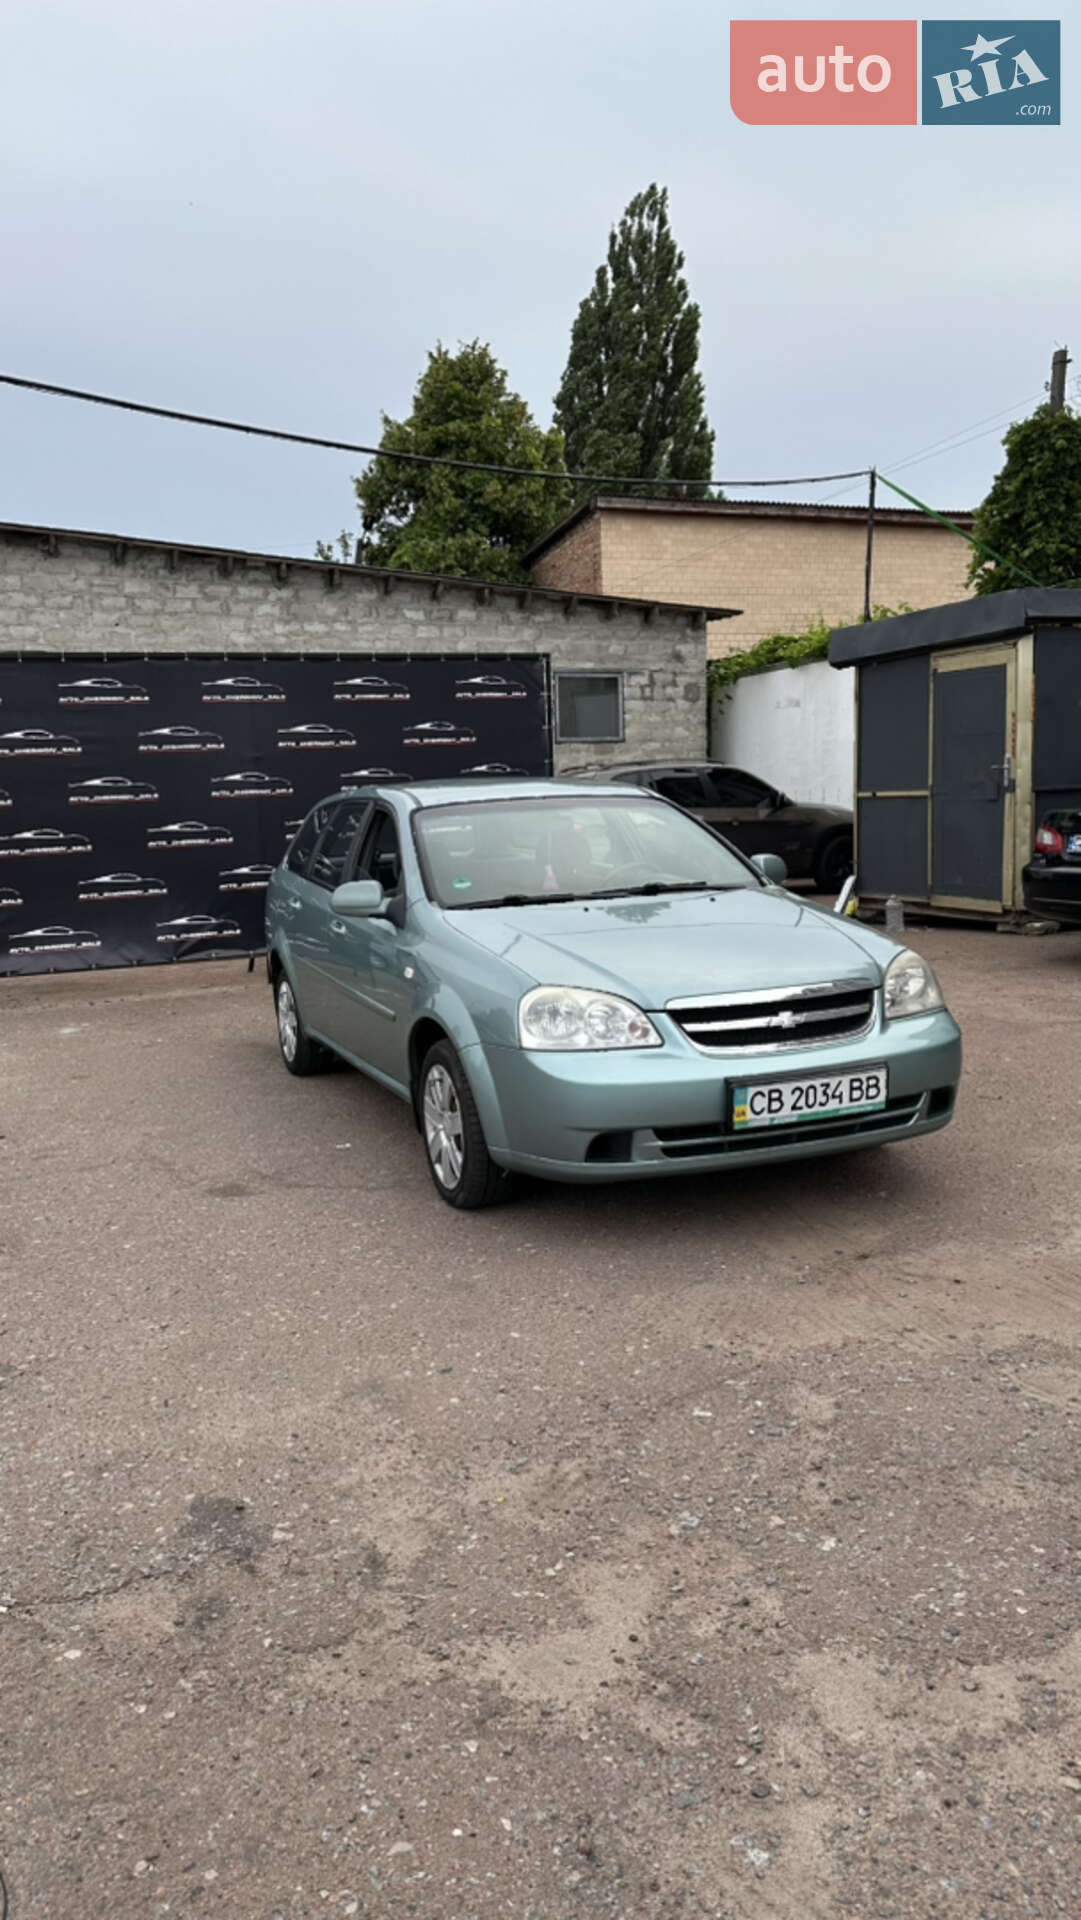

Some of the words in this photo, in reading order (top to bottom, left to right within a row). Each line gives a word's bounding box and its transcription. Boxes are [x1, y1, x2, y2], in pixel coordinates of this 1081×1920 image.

[749, 1088, 785, 1116] CB
[790, 1080, 843, 1112] 2034
[849, 1075, 881, 1103] BB
